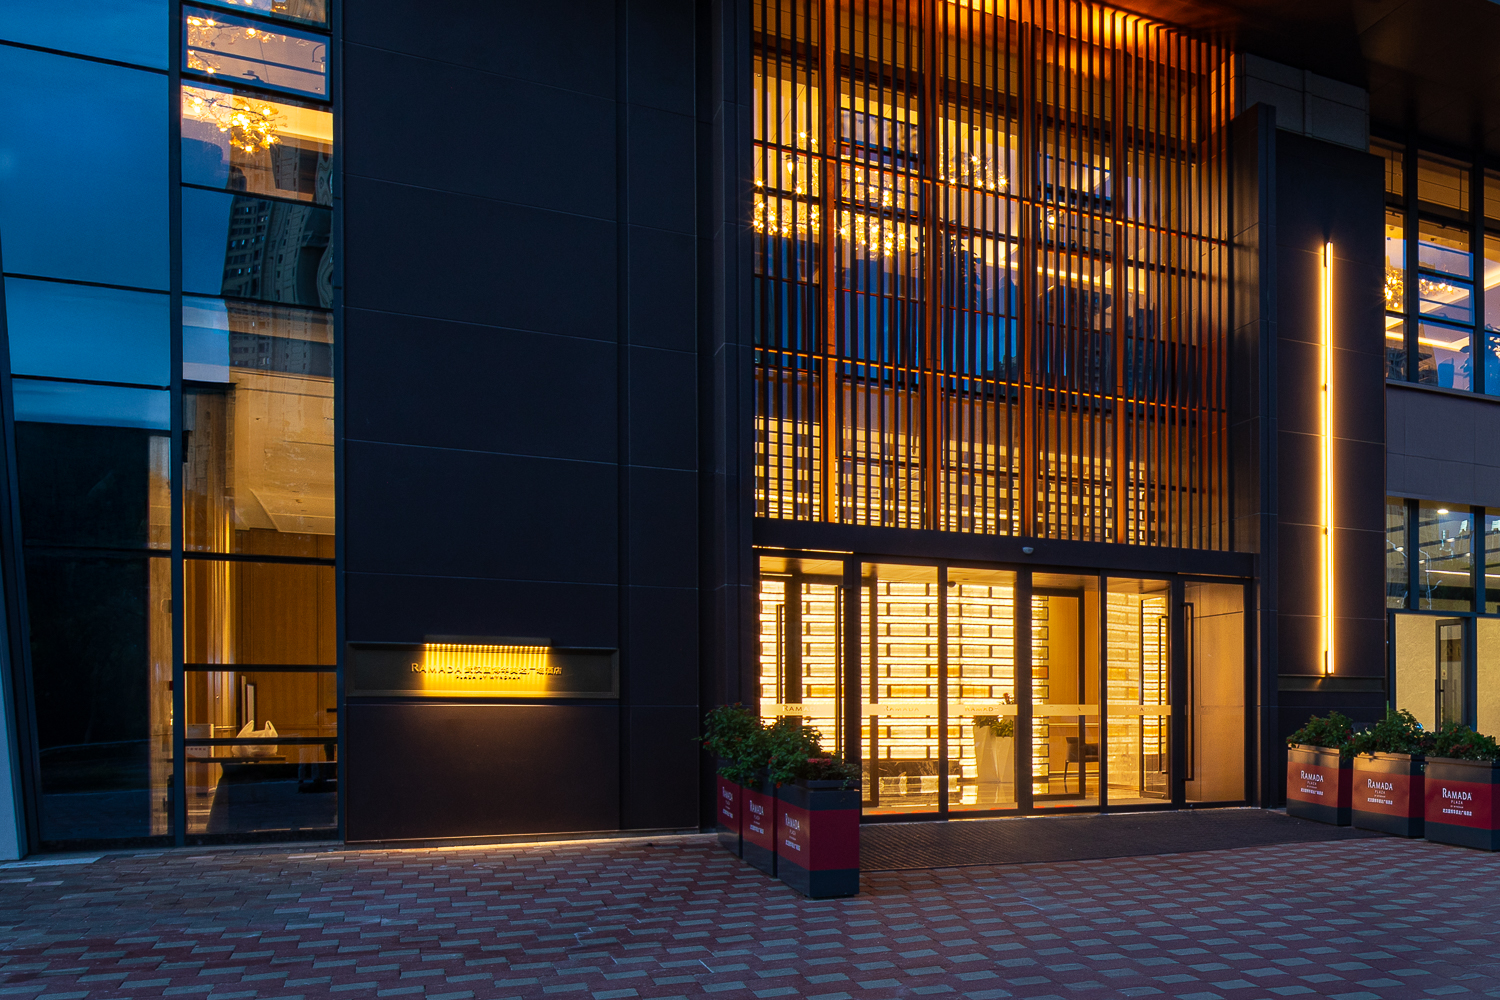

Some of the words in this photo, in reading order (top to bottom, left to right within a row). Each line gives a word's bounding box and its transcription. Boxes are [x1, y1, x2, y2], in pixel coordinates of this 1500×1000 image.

[1300, 770, 1324, 783] RAMADA
[1367, 778, 1393, 791] RAMADA
[1442, 787, 1472, 801] RAMADA
